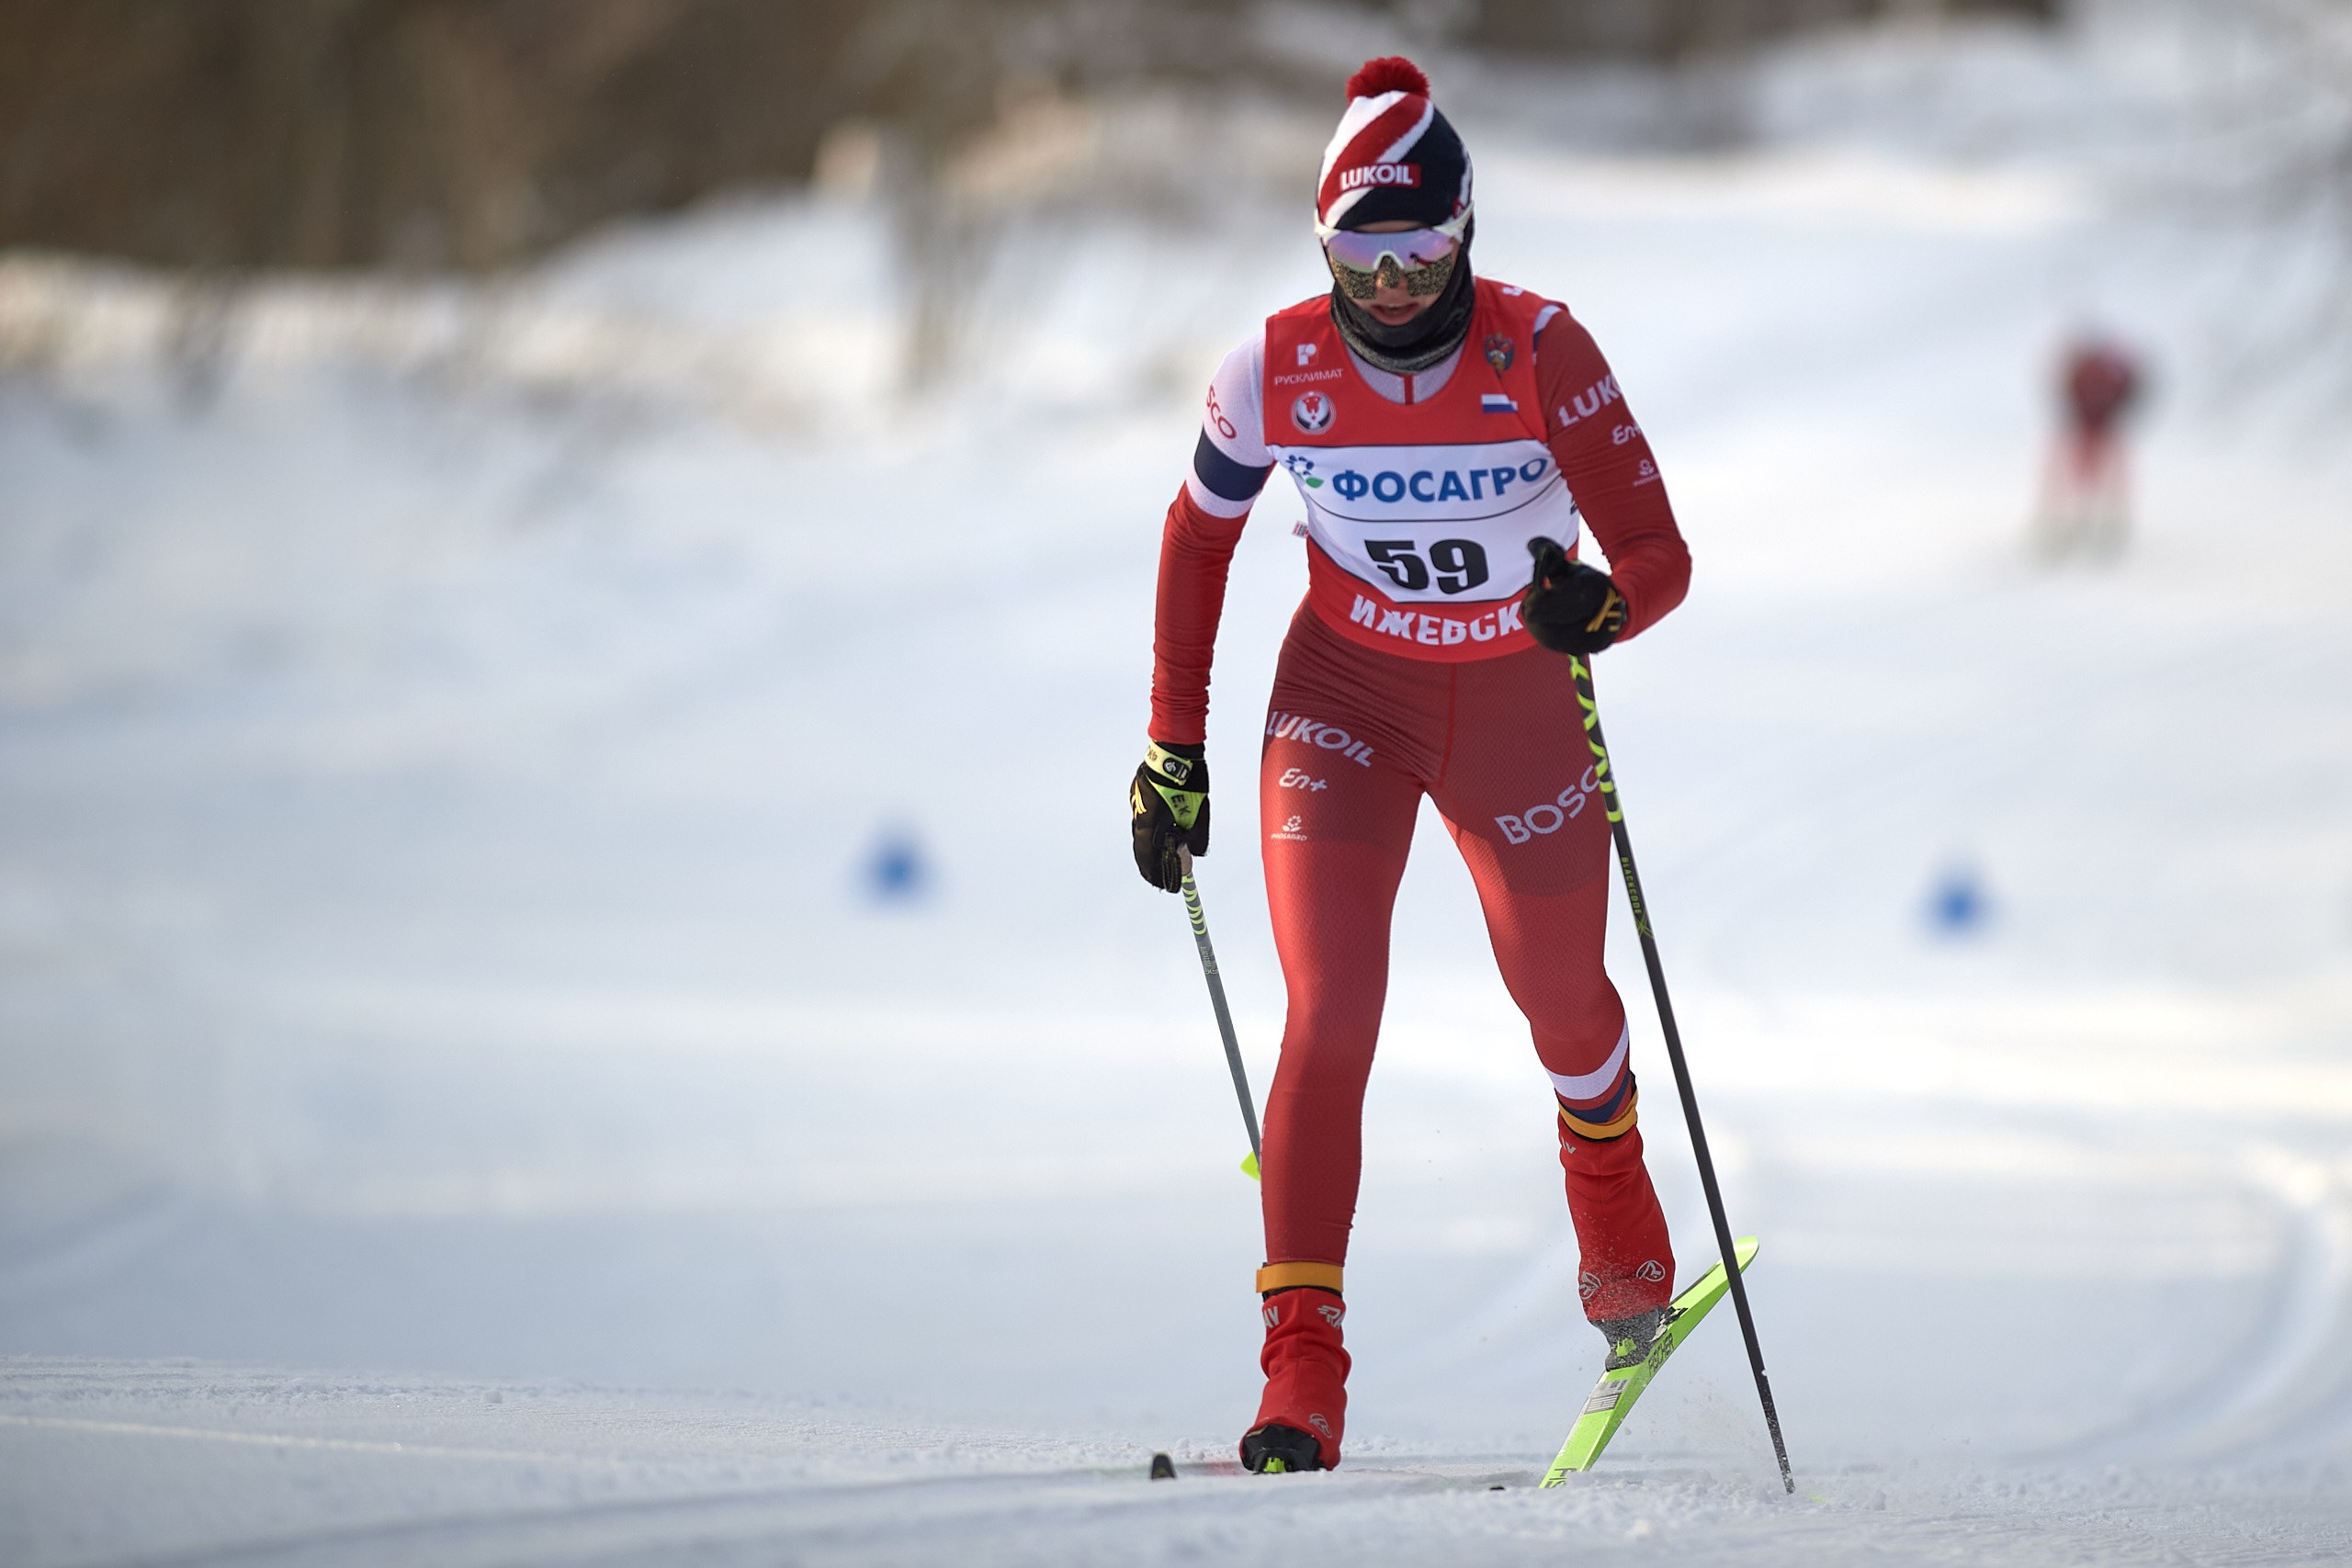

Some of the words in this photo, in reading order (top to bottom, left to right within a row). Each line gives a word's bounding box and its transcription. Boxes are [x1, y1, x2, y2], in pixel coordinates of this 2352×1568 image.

[1340, 164, 1414, 190] LUKOIL
[1273, 367, 1344, 386] РУСКЛИМАТ
[1557, 373, 1623, 427] LUK
[1332, 457, 1547, 502] ФОСАГРО
[1364, 538, 1489, 595] 59
[1350, 593, 1524, 646] ИЖЕВСК
[1266, 710, 1376, 767] LUKOIL
[1279, 767, 1329, 792] En+
[1495, 764, 1600, 845] BOSC
